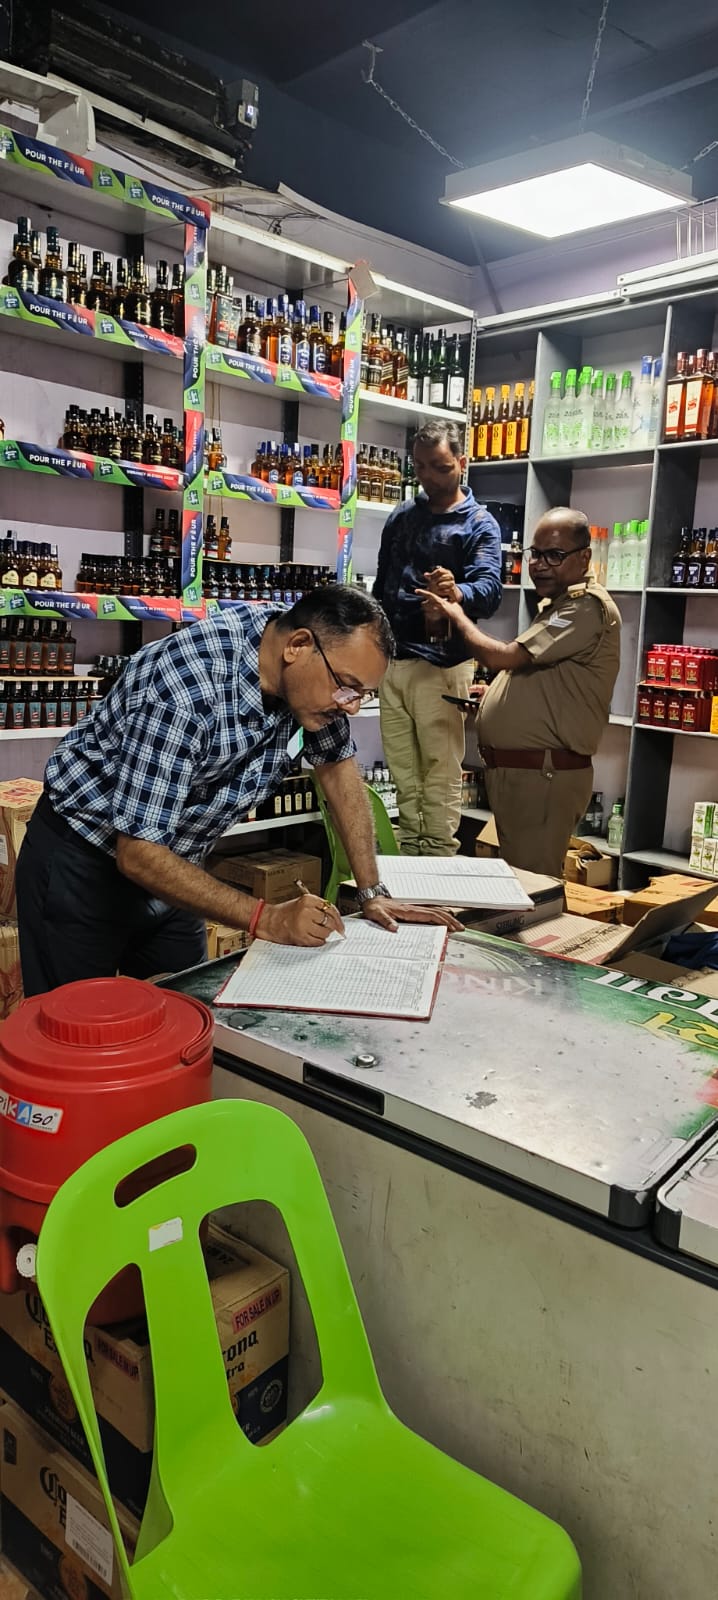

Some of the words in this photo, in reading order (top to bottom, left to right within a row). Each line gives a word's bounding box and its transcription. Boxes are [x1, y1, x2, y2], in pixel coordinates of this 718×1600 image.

[25, 148, 47, 162] POUR
[48, 155, 63, 168] THE
[151, 194, 171, 207] POUR
[171, 200, 184, 211] THE
[29, 303, 51, 316] POUR
[51, 309, 66, 320] THE
[228, 358, 245, 369] POUR
[245, 361, 257, 371] THE
[29, 453, 50, 464] POUR
[51, 457, 65, 468] THE
[230, 483, 245, 491] POUR
[245, 485, 258, 493] THE
[34, 600, 55, 609] POUR
[56, 601, 70, 609] THE
[235, 1310, 250, 1329] FOR
[249, 1299, 266, 1319] SALE
